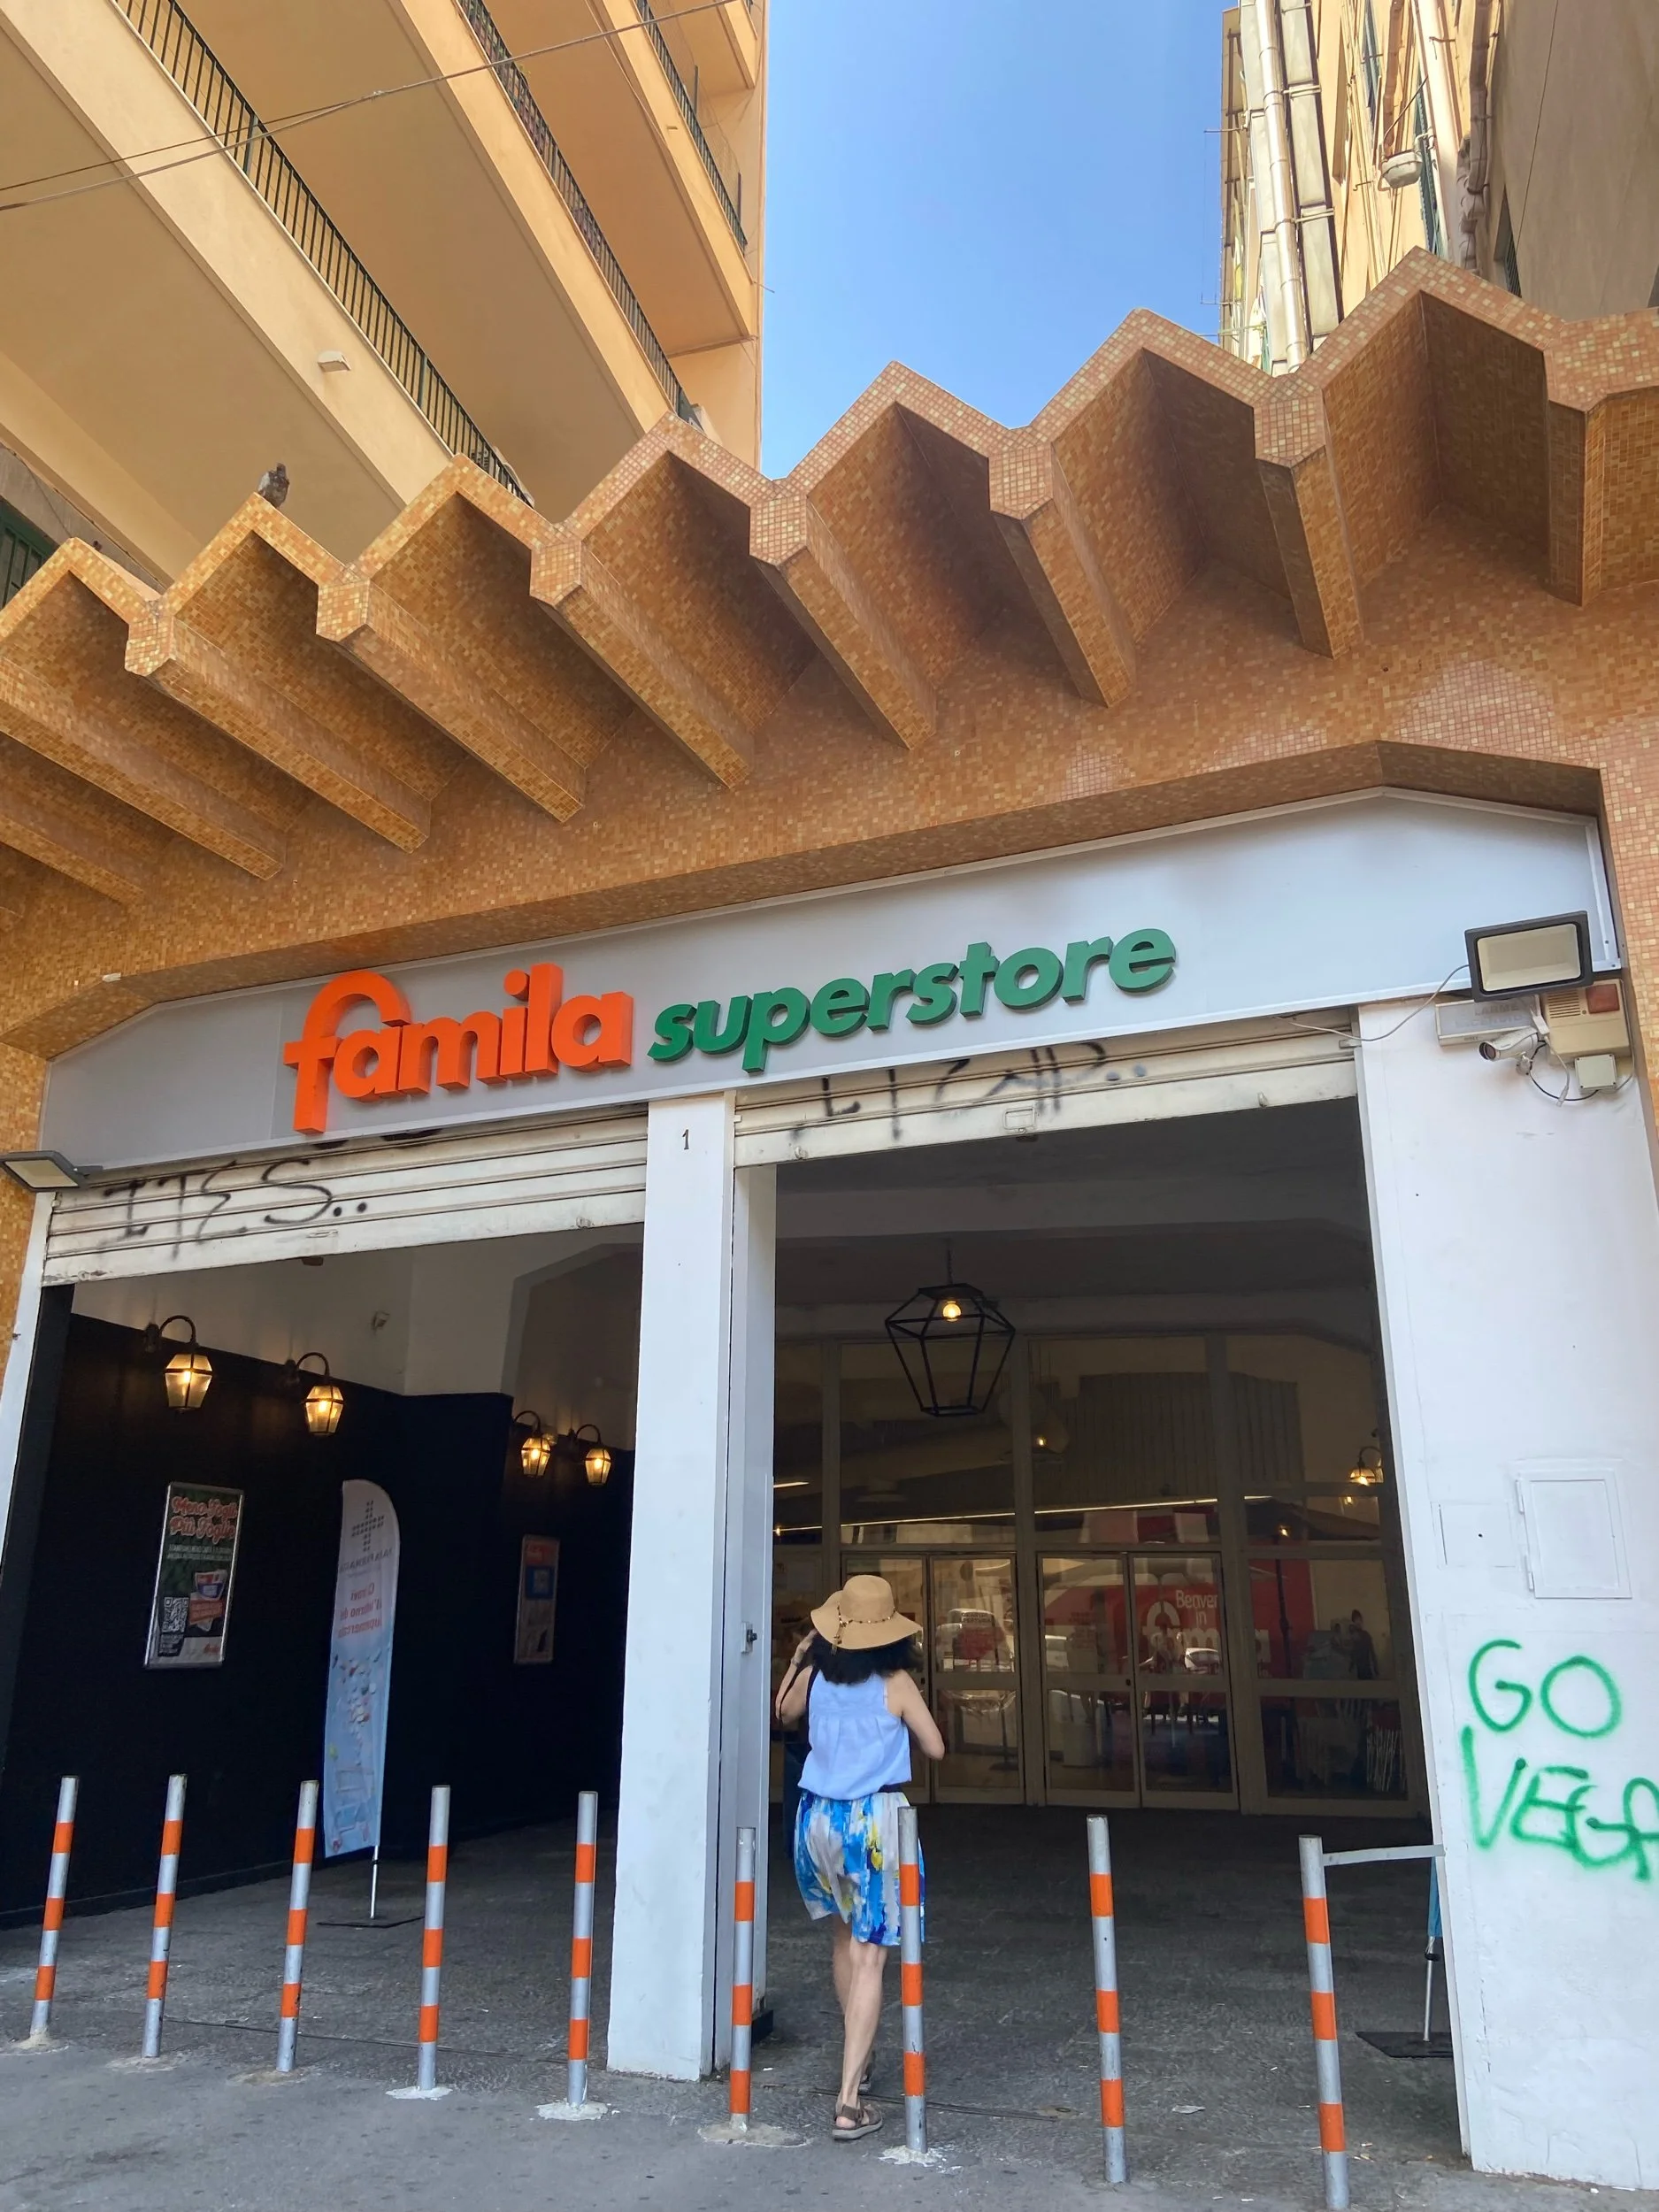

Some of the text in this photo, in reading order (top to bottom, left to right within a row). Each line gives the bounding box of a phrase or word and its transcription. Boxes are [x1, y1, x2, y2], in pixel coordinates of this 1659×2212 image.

[284, 964, 632, 1133] famila
[648, 929, 1174, 1072] superstore
[681, 1128, 690, 1150] 1
[1467, 1637, 1624, 1740] GO
